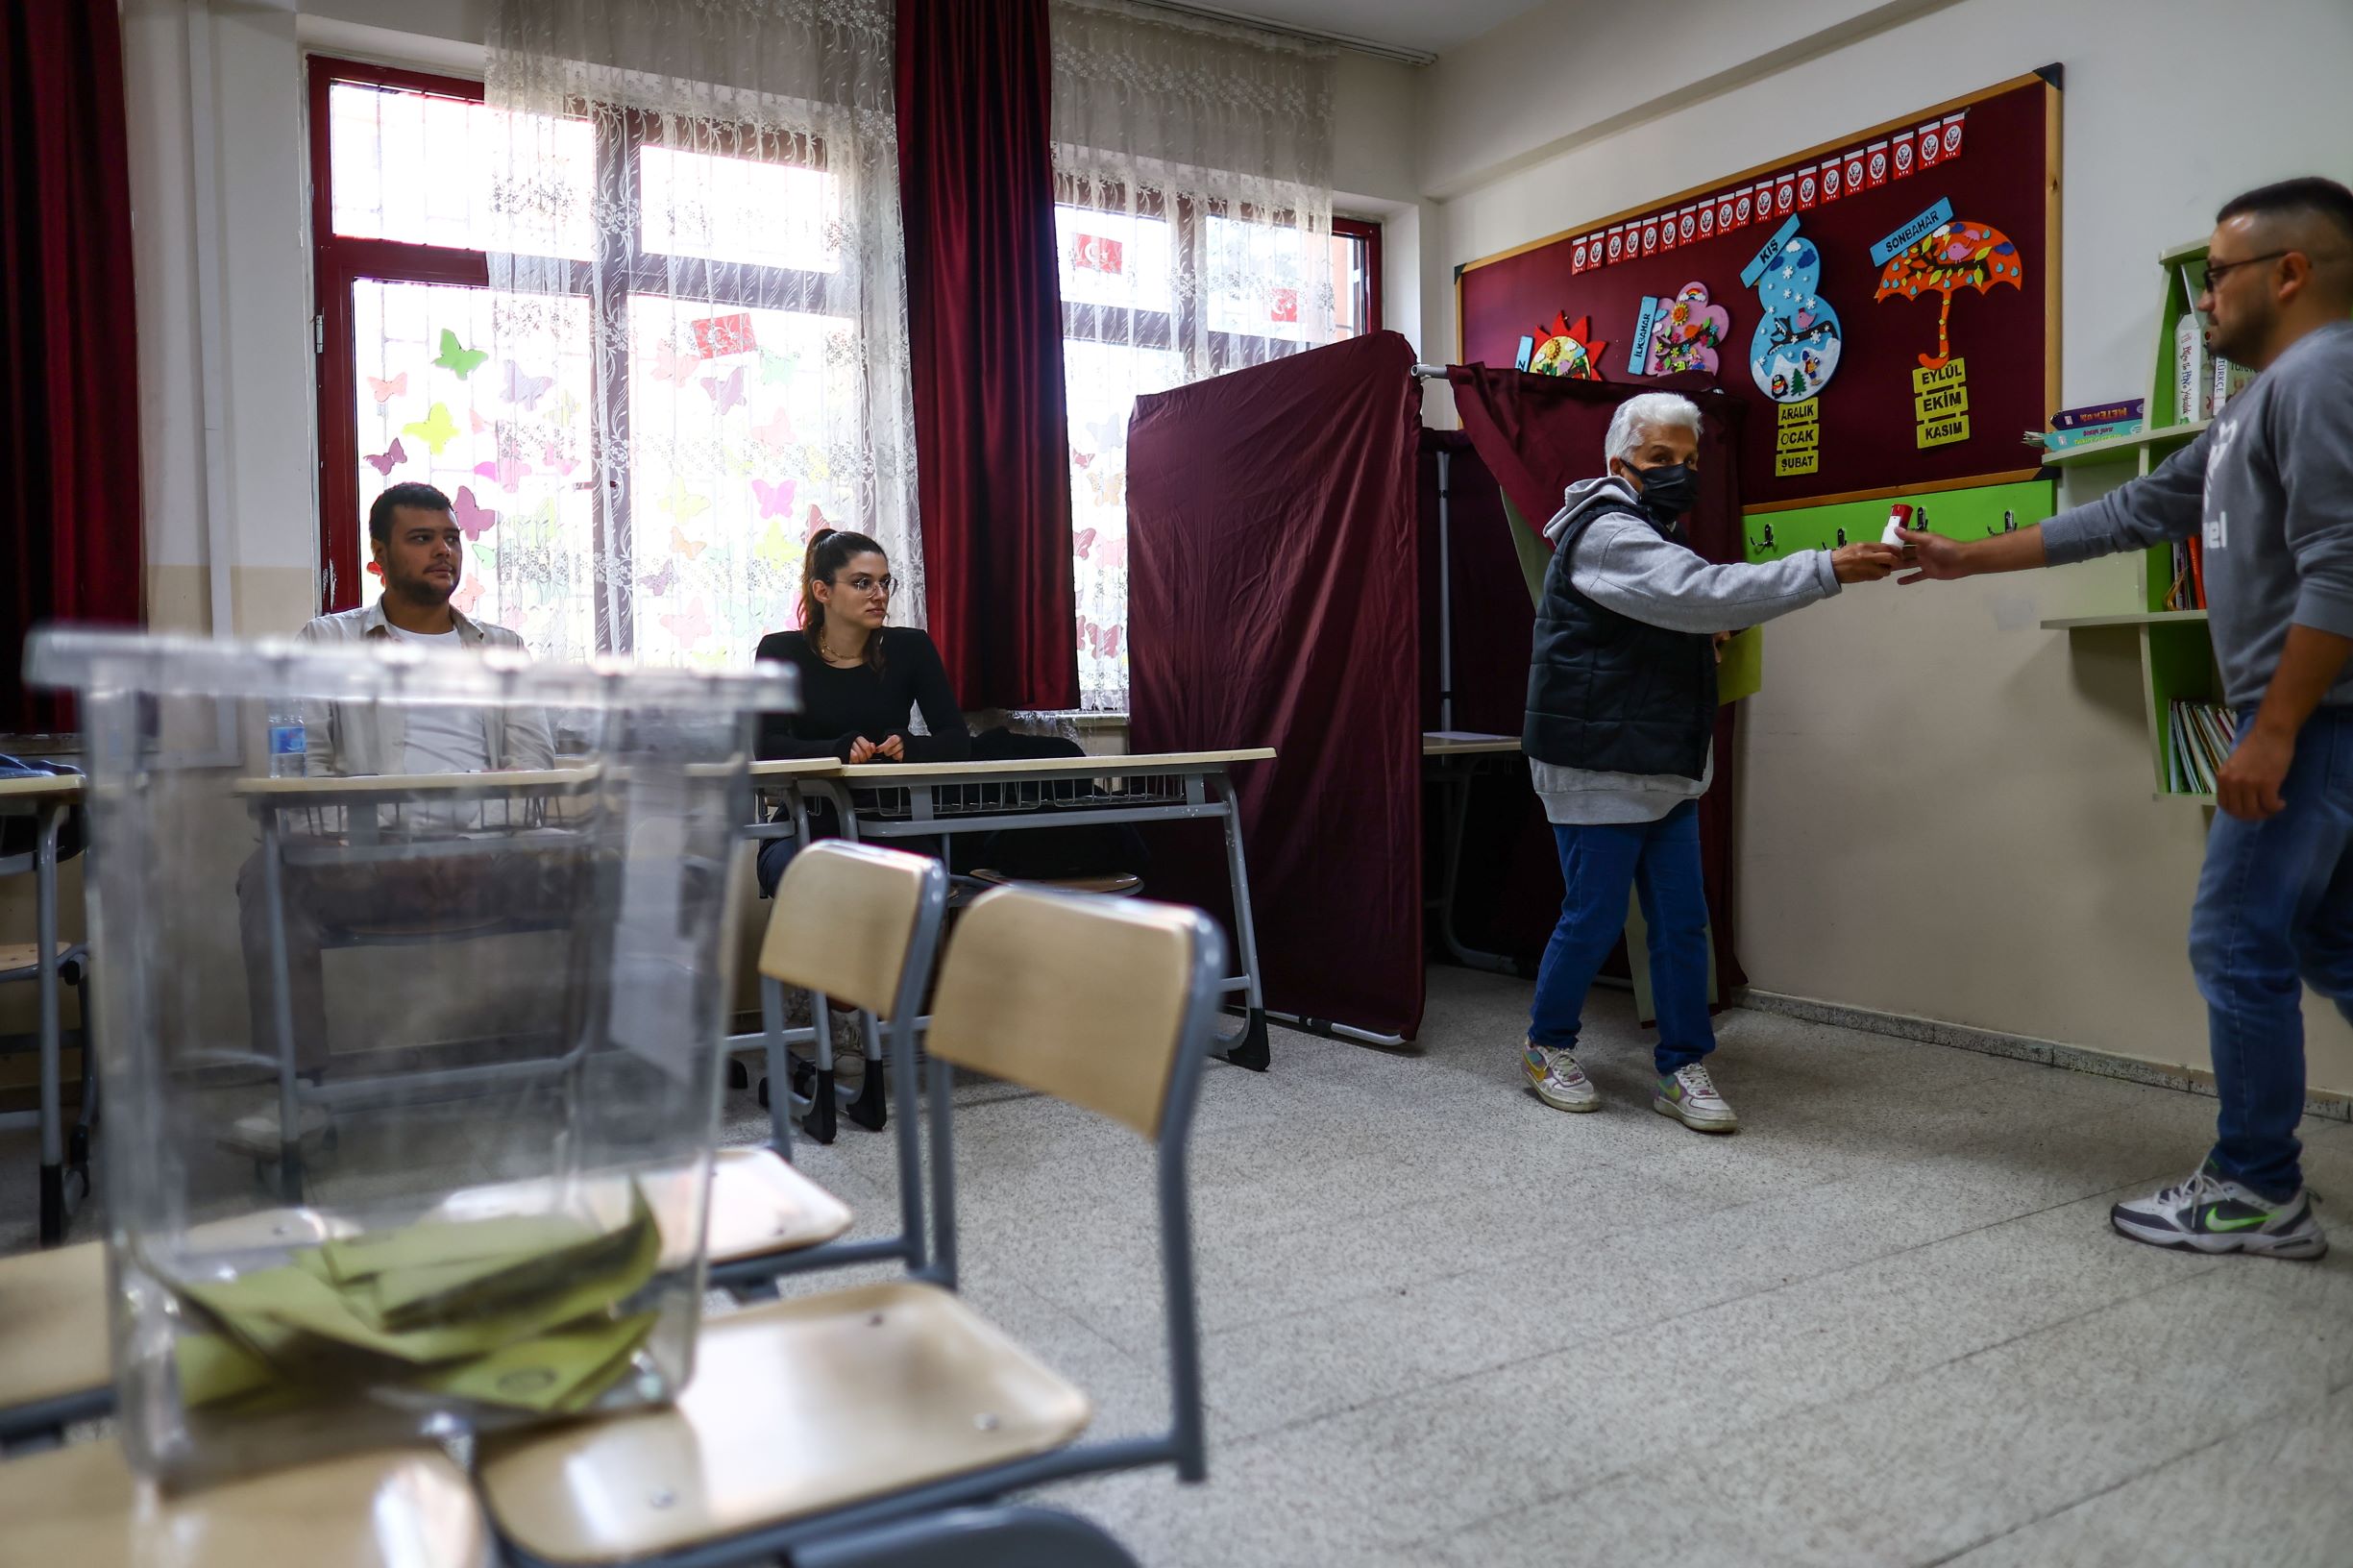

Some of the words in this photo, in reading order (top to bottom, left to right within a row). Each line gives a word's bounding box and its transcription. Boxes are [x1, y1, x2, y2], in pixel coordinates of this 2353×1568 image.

[1885, 210, 1939, 252] SONBAHAR
[1759, 239, 1778, 264] KIŞ
[1922, 364, 1962, 385] EYLÜL
[2217, 359, 2226, 393] TÜRKÇE
[1923, 391, 1962, 412] EKİM
[1781, 404, 1814, 421] ARALIK
[1781, 429, 1814, 445] OCAK
[1925, 422, 1963, 440] KASIM
[1781, 455, 1814, 472] ŞUBAT
